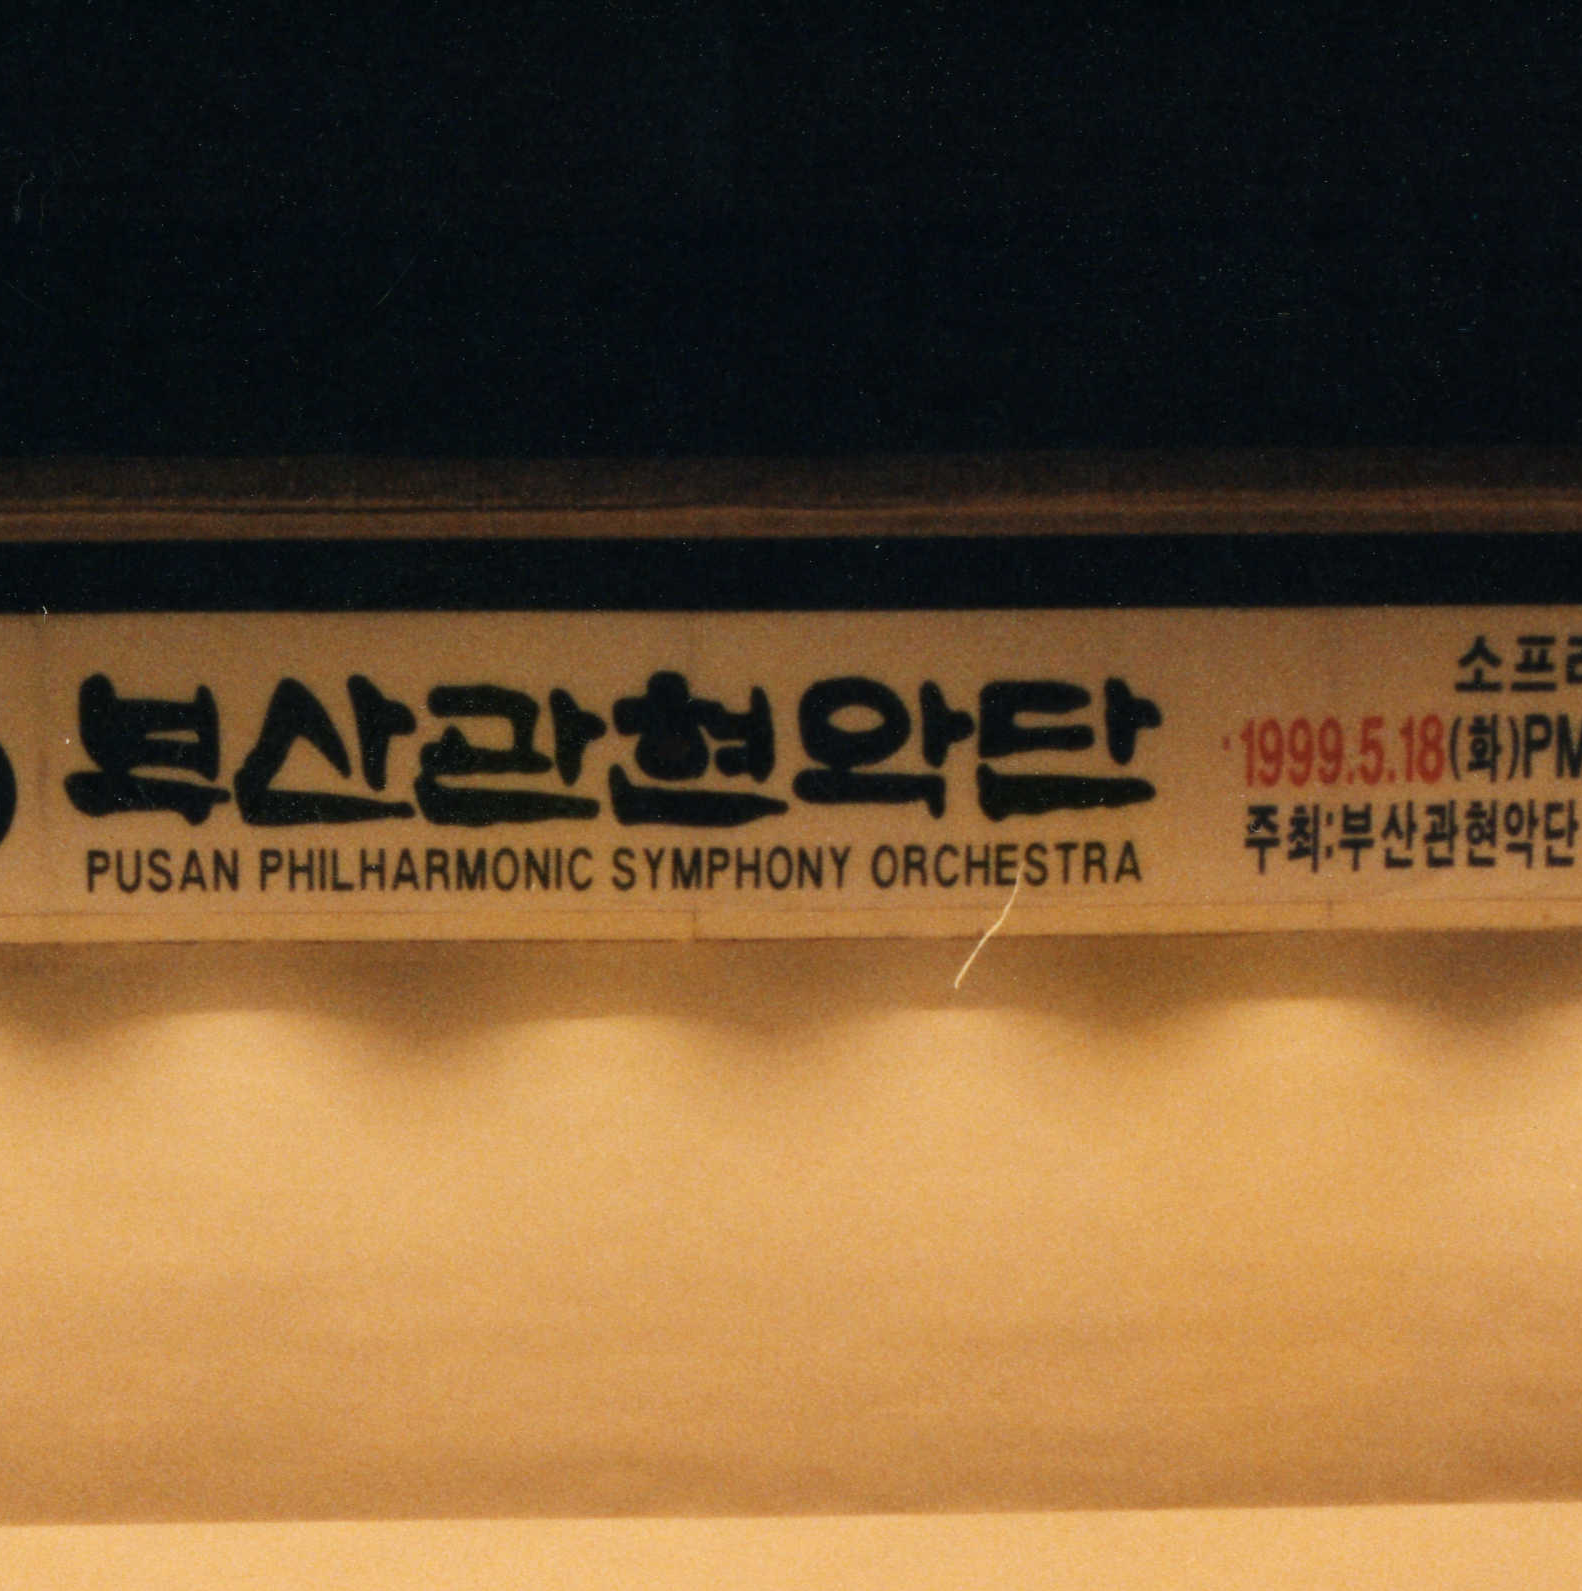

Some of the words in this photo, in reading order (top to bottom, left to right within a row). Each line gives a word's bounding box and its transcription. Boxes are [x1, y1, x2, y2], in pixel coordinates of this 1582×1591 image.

[63, 671, 1162, 828] 부산관현악단
[86, 848, 240, 895] PUSAN
[258, 846, 593, 892] PHILHARMONIC
[611, 844, 852, 892] SYMPHONY
[870, 839, 1143, 890] ORCHESTRA
[1244, 800, 1580, 873] 주최:부산관현악단
